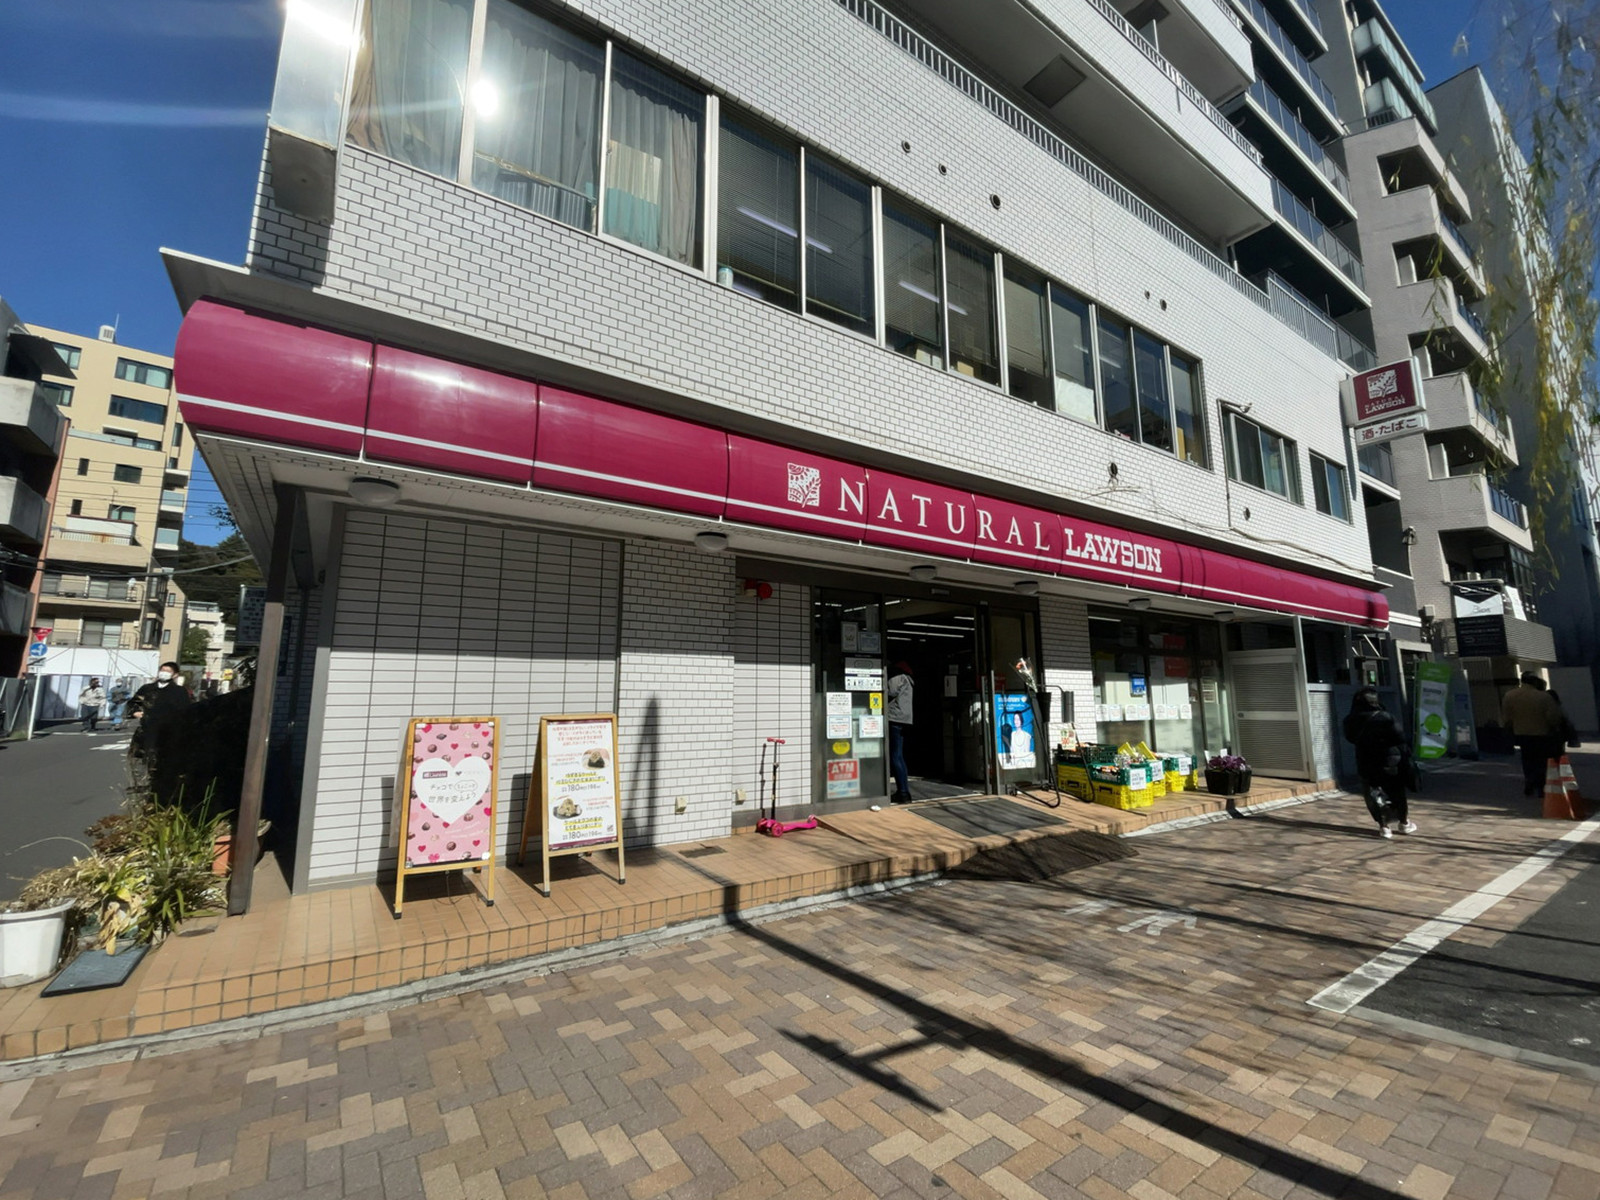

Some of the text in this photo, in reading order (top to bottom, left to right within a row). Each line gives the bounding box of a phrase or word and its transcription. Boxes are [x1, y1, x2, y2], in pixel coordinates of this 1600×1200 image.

[1364, 394, 1406, 409] NATURAL
[1365, 398, 1406, 415] LAWSON
[1362, 418, 1418, 441] 酒・たばこ
[838, 476, 1163, 574] NATURAL LAWSON
[831, 762, 855, 774] ATM
